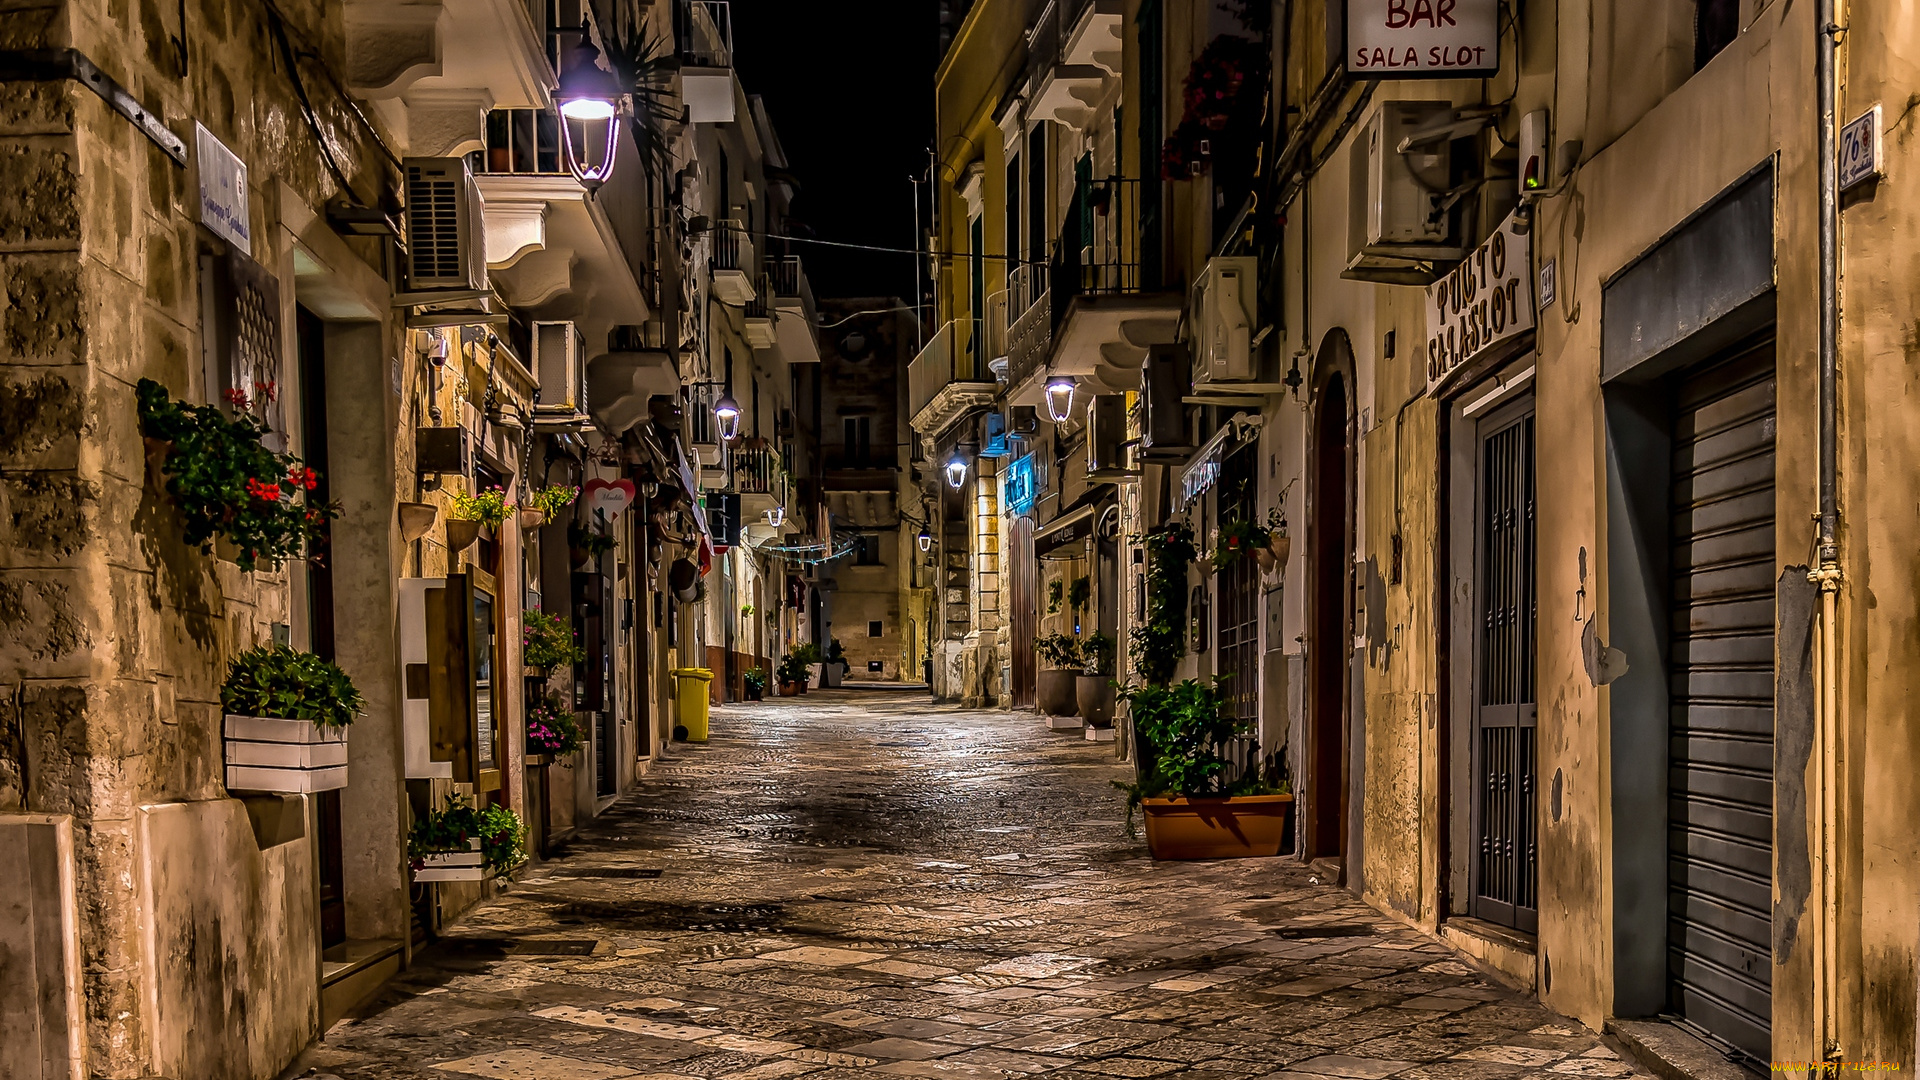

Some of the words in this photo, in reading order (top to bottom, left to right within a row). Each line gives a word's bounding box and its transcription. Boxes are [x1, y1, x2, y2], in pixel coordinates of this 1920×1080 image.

[1385, 0, 1456, 28] BAR
[1356, 47, 1418, 67] SALA
[1428, 46, 1485, 66] SLOT
[1843, 127, 1859, 167] 76
